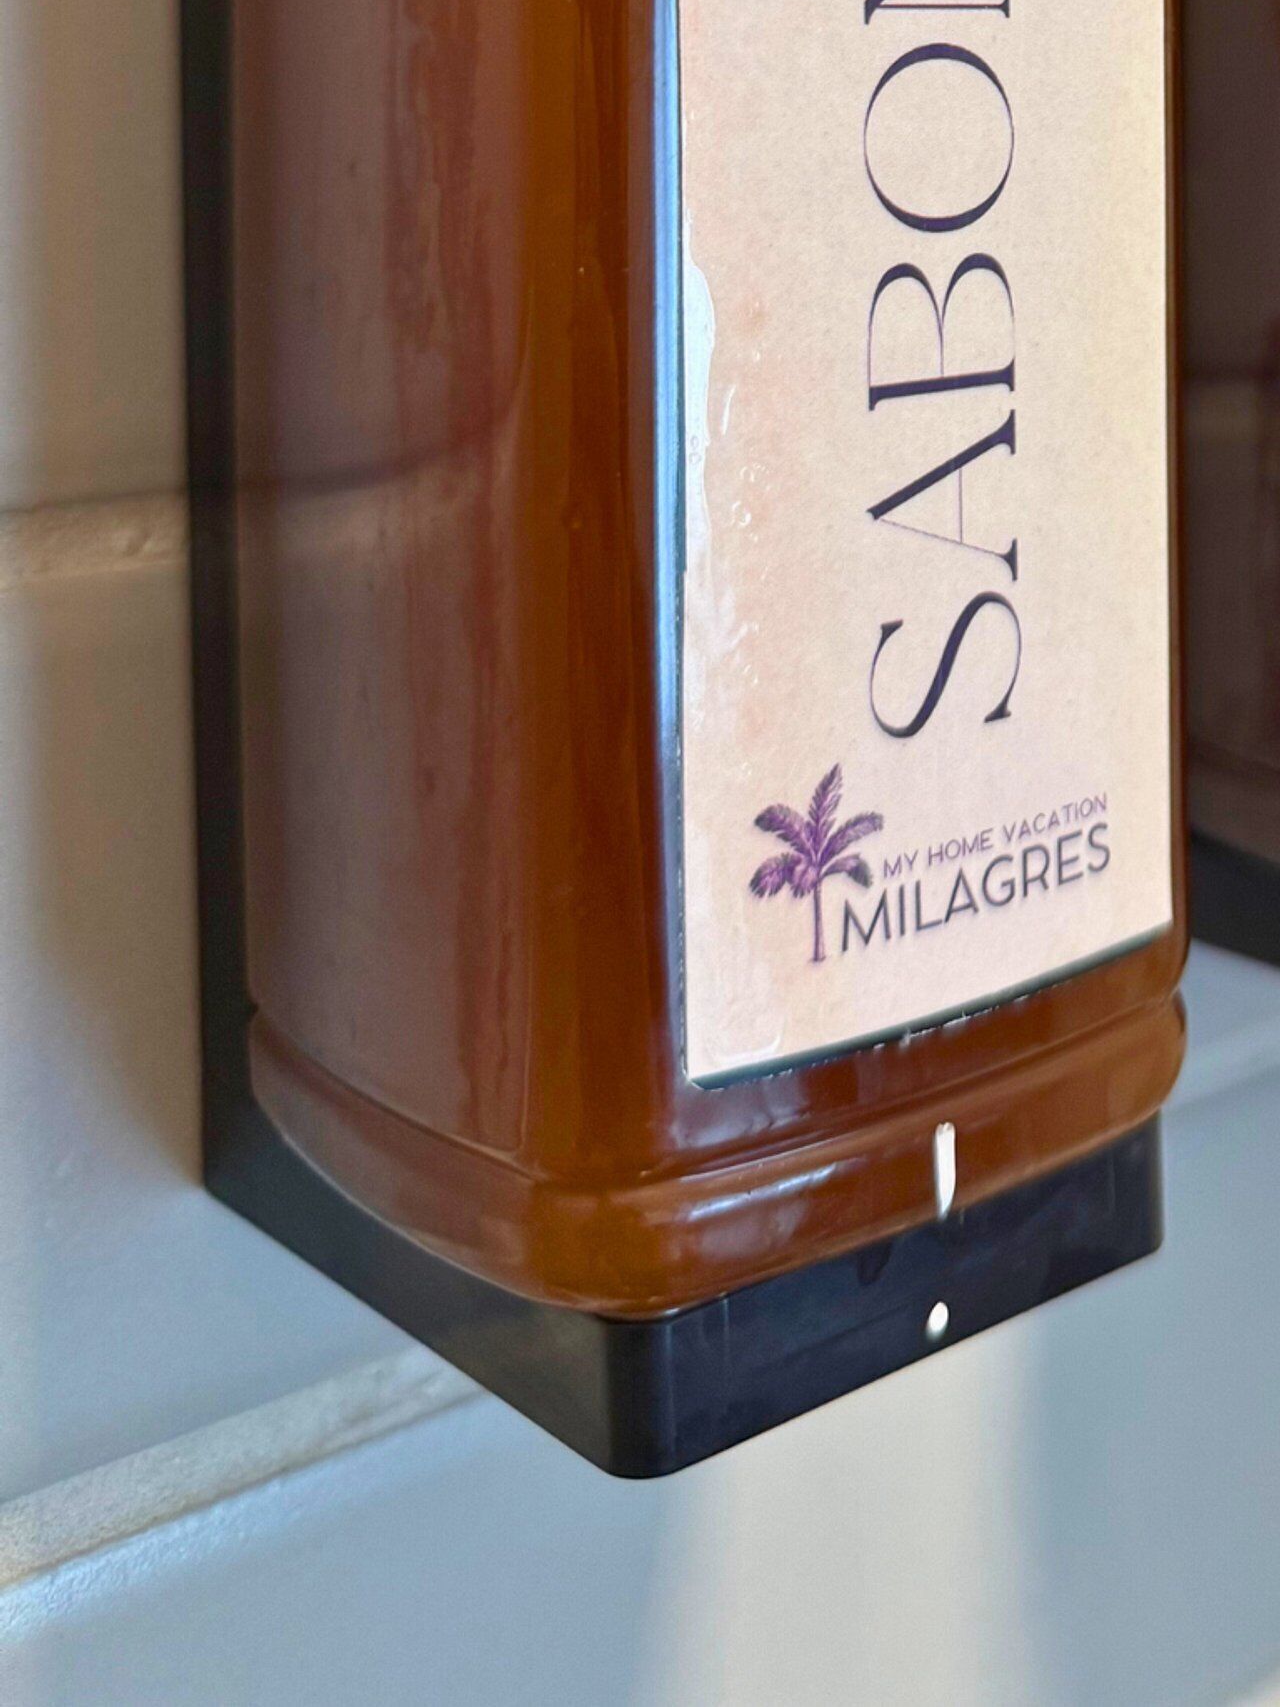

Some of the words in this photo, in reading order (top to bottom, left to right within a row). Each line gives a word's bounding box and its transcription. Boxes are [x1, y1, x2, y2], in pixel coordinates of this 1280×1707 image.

[840, 822, 1112, 953] MILAGRES
[882, 849, 918, 879] MY
[928, 828, 995, 867] HOME
[1002, 791, 1109, 845] VACATION
